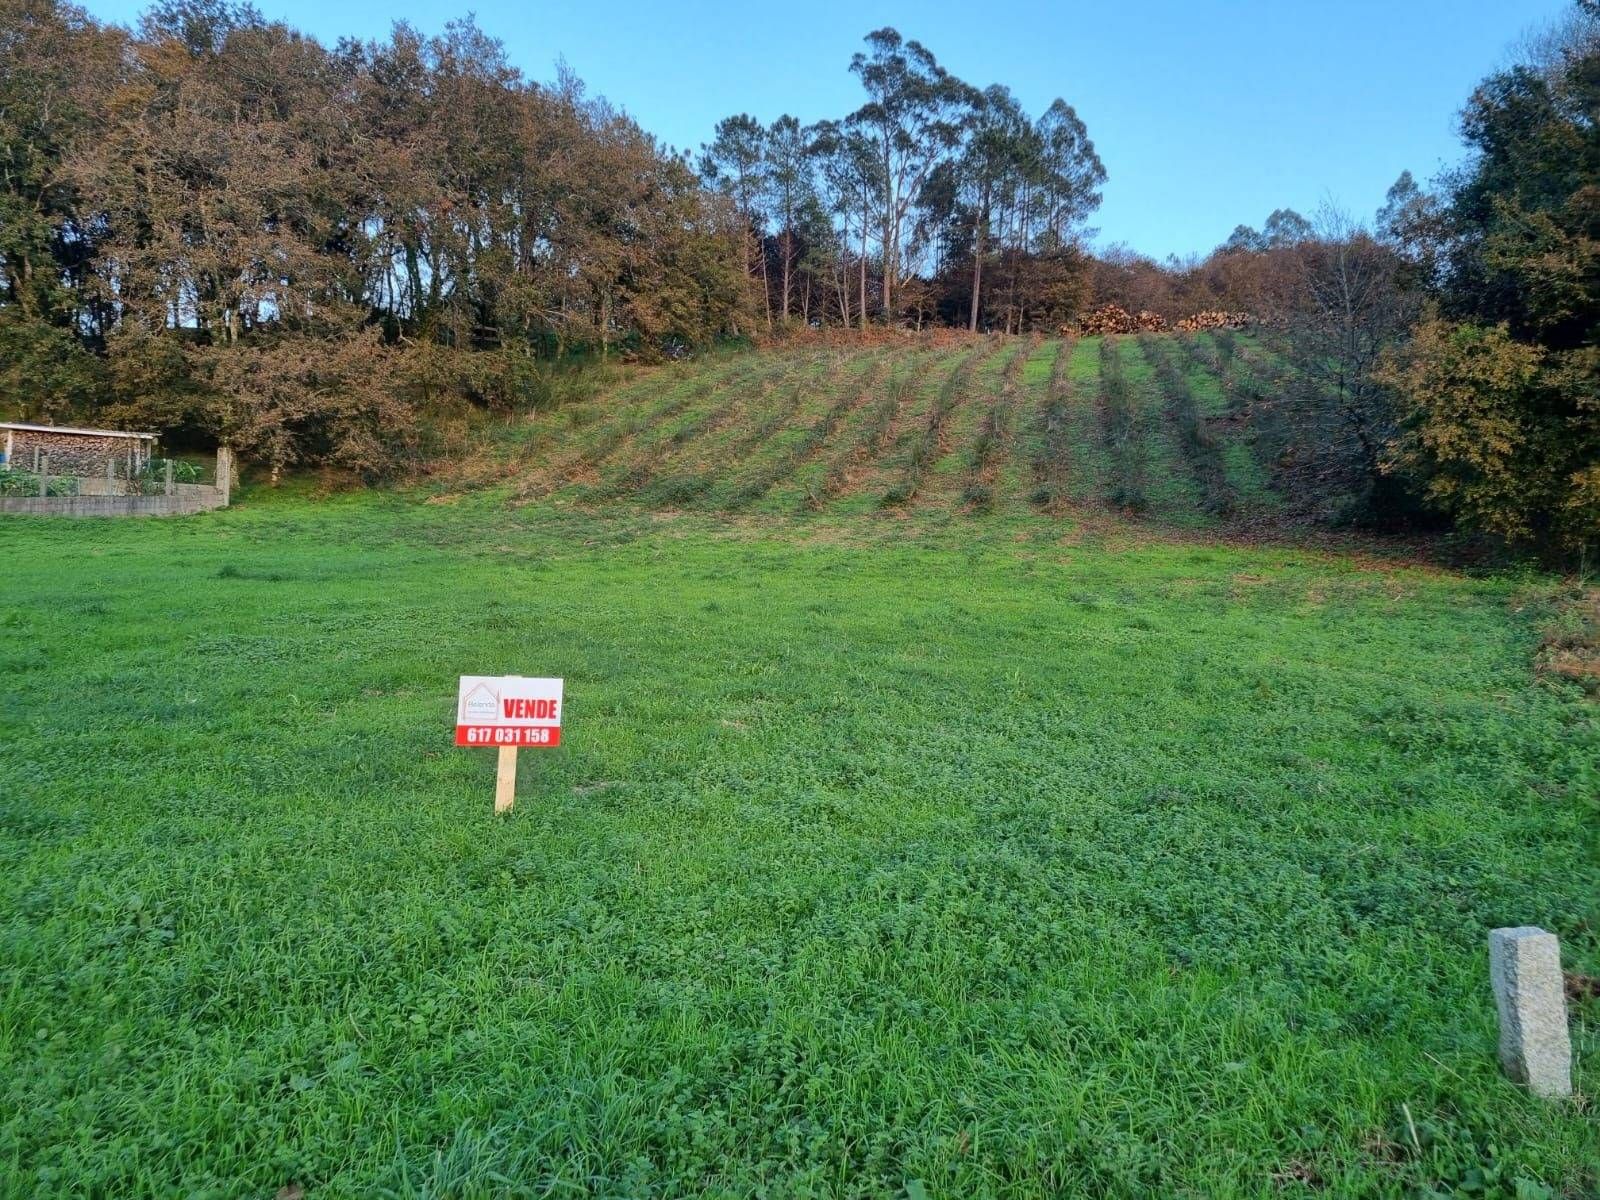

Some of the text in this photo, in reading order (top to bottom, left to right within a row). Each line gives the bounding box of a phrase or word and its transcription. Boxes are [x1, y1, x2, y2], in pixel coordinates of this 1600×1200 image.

[504, 698, 557, 719] VENDE
[467, 728, 550, 743] 617 031 158
